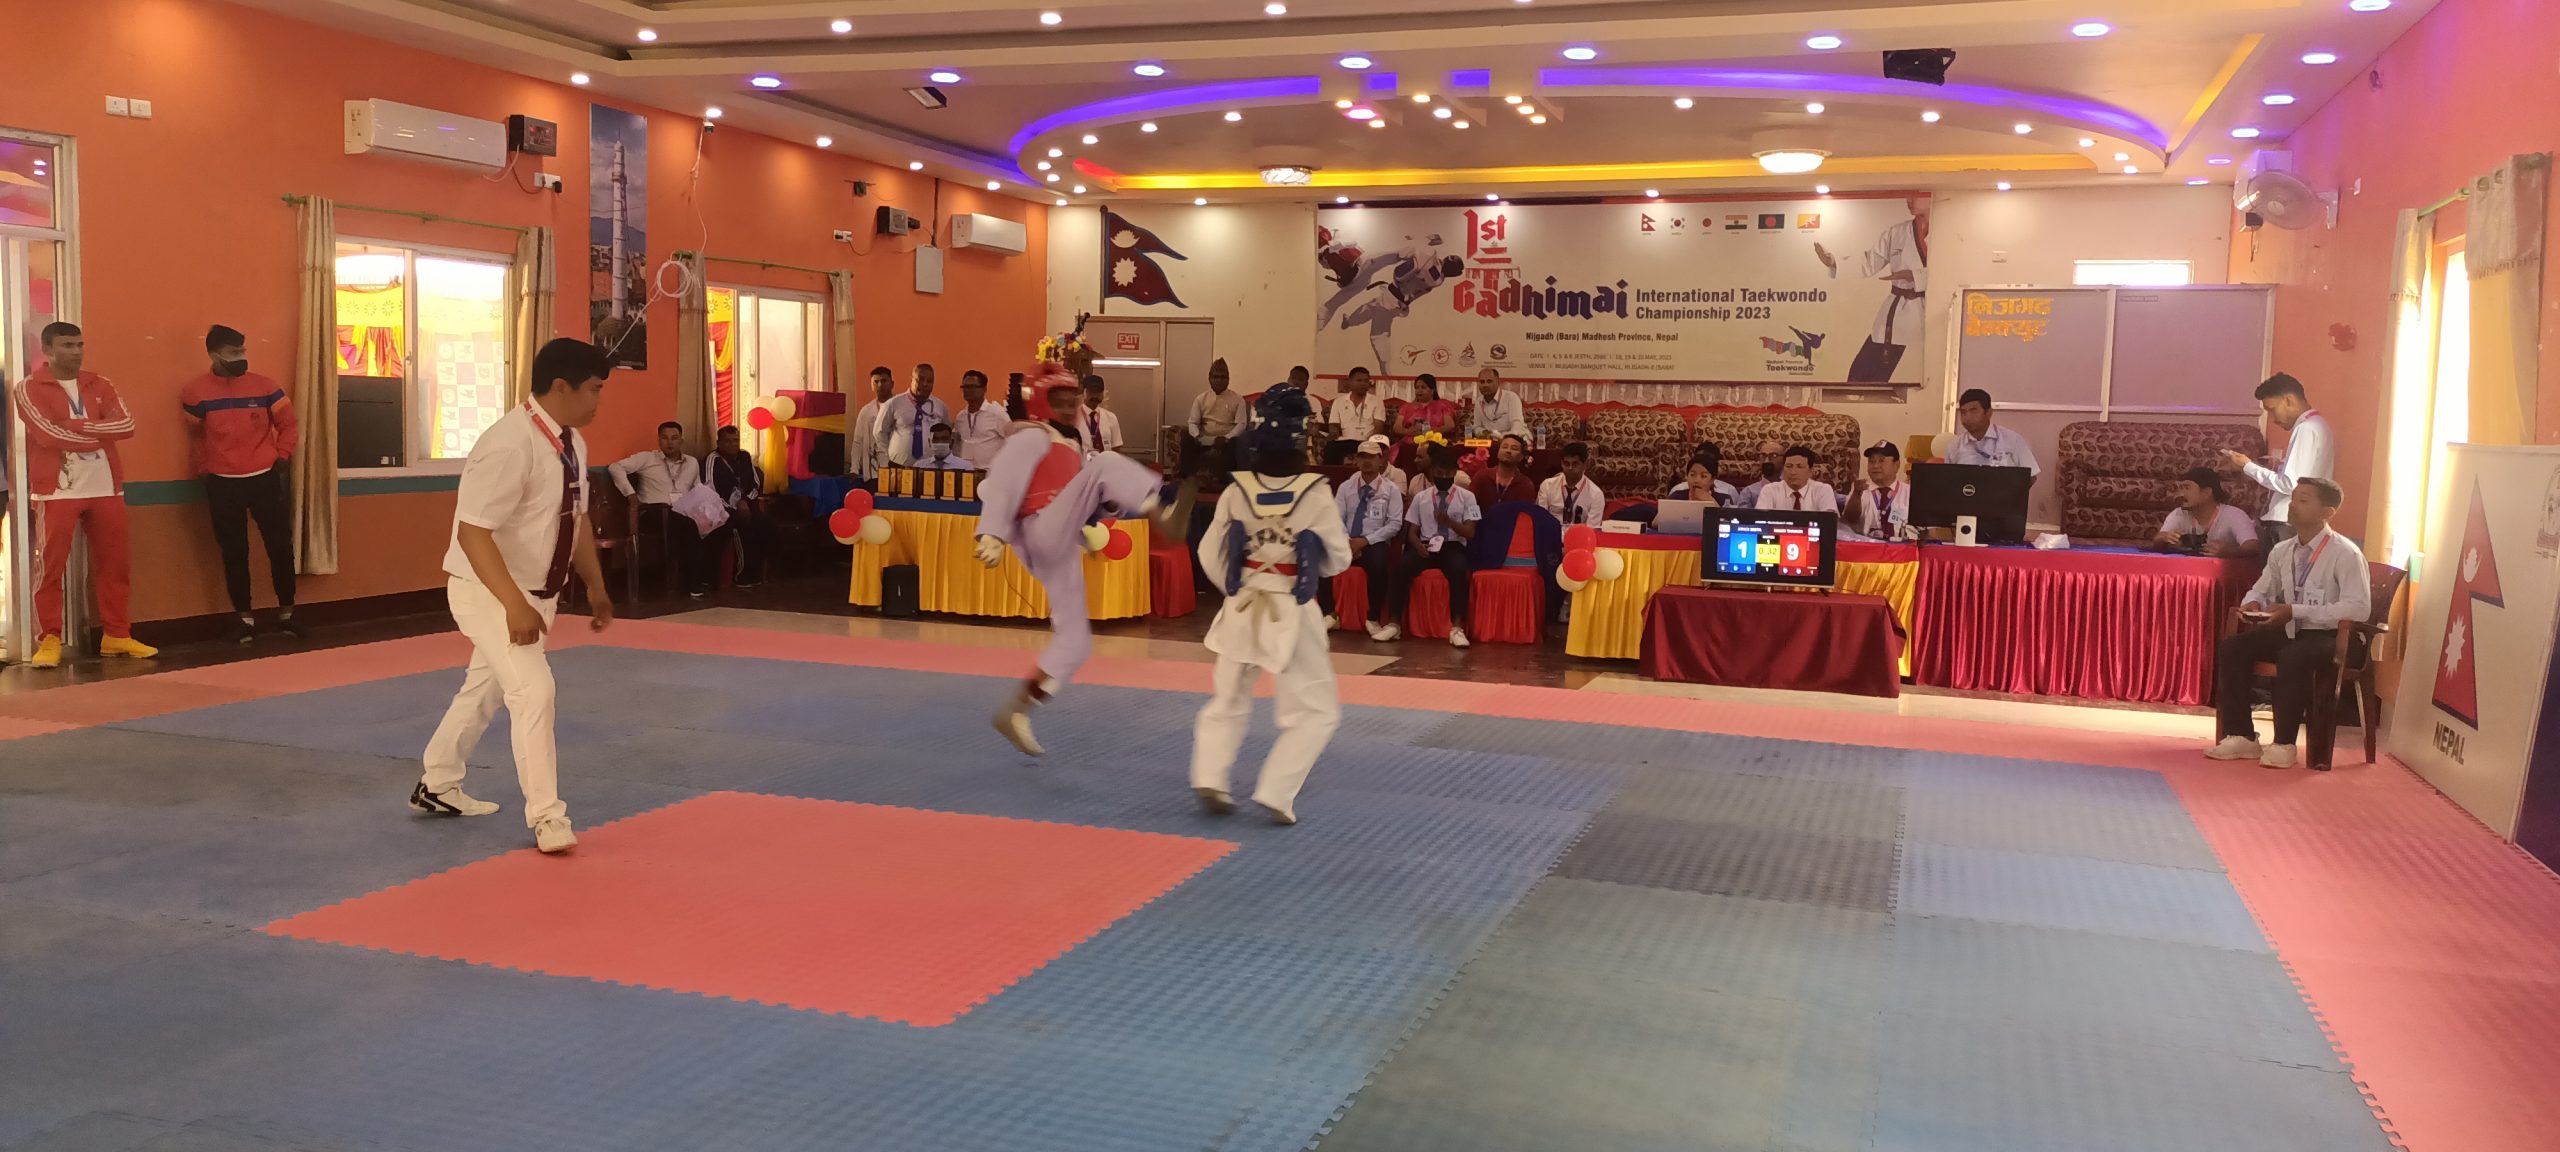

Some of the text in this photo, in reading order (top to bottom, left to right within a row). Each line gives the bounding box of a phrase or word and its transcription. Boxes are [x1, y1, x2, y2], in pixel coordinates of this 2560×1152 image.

[1464, 209, 1507, 260] 1st
[1453, 275, 1629, 320] Gadhimai
[1636, 288, 1827, 303] International Taekwondo
[1636, 306, 1771, 322] Championship 2023
[1118, 334, 1139, 344] EXIT
[1526, 332, 1679, 342] Nijgadh (Bara) Madhesh Province, Nepal
[1766, 364, 1815, 372] Taekwondo
[1738, 541, 1748, 558] 1
[1786, 543, 1800, 561] 9
[2433, 721, 2464, 765] NEPAL
